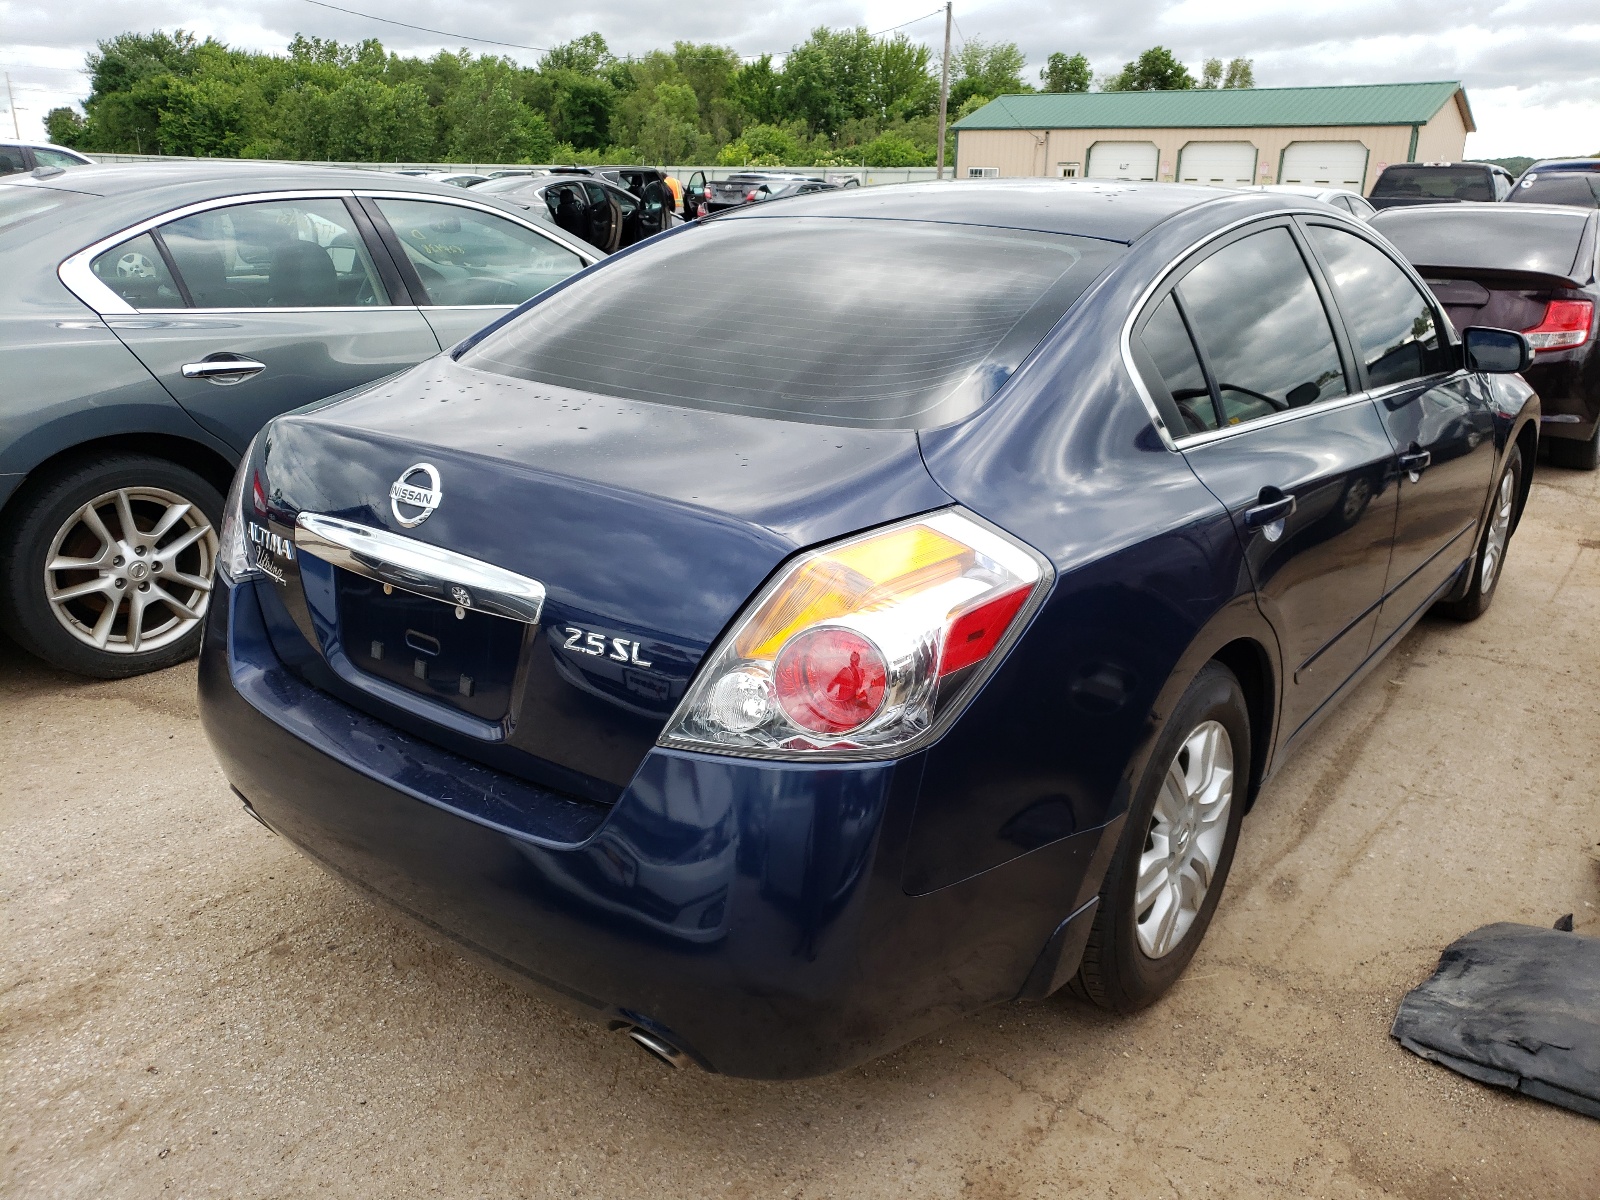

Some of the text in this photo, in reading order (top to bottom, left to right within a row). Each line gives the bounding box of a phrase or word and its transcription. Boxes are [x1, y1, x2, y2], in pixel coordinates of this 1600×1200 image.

[390, 485, 433, 505] NISSAN
[247, 521, 294, 560] ALTIMA
[563, 627, 653, 667] 2.5 SL
